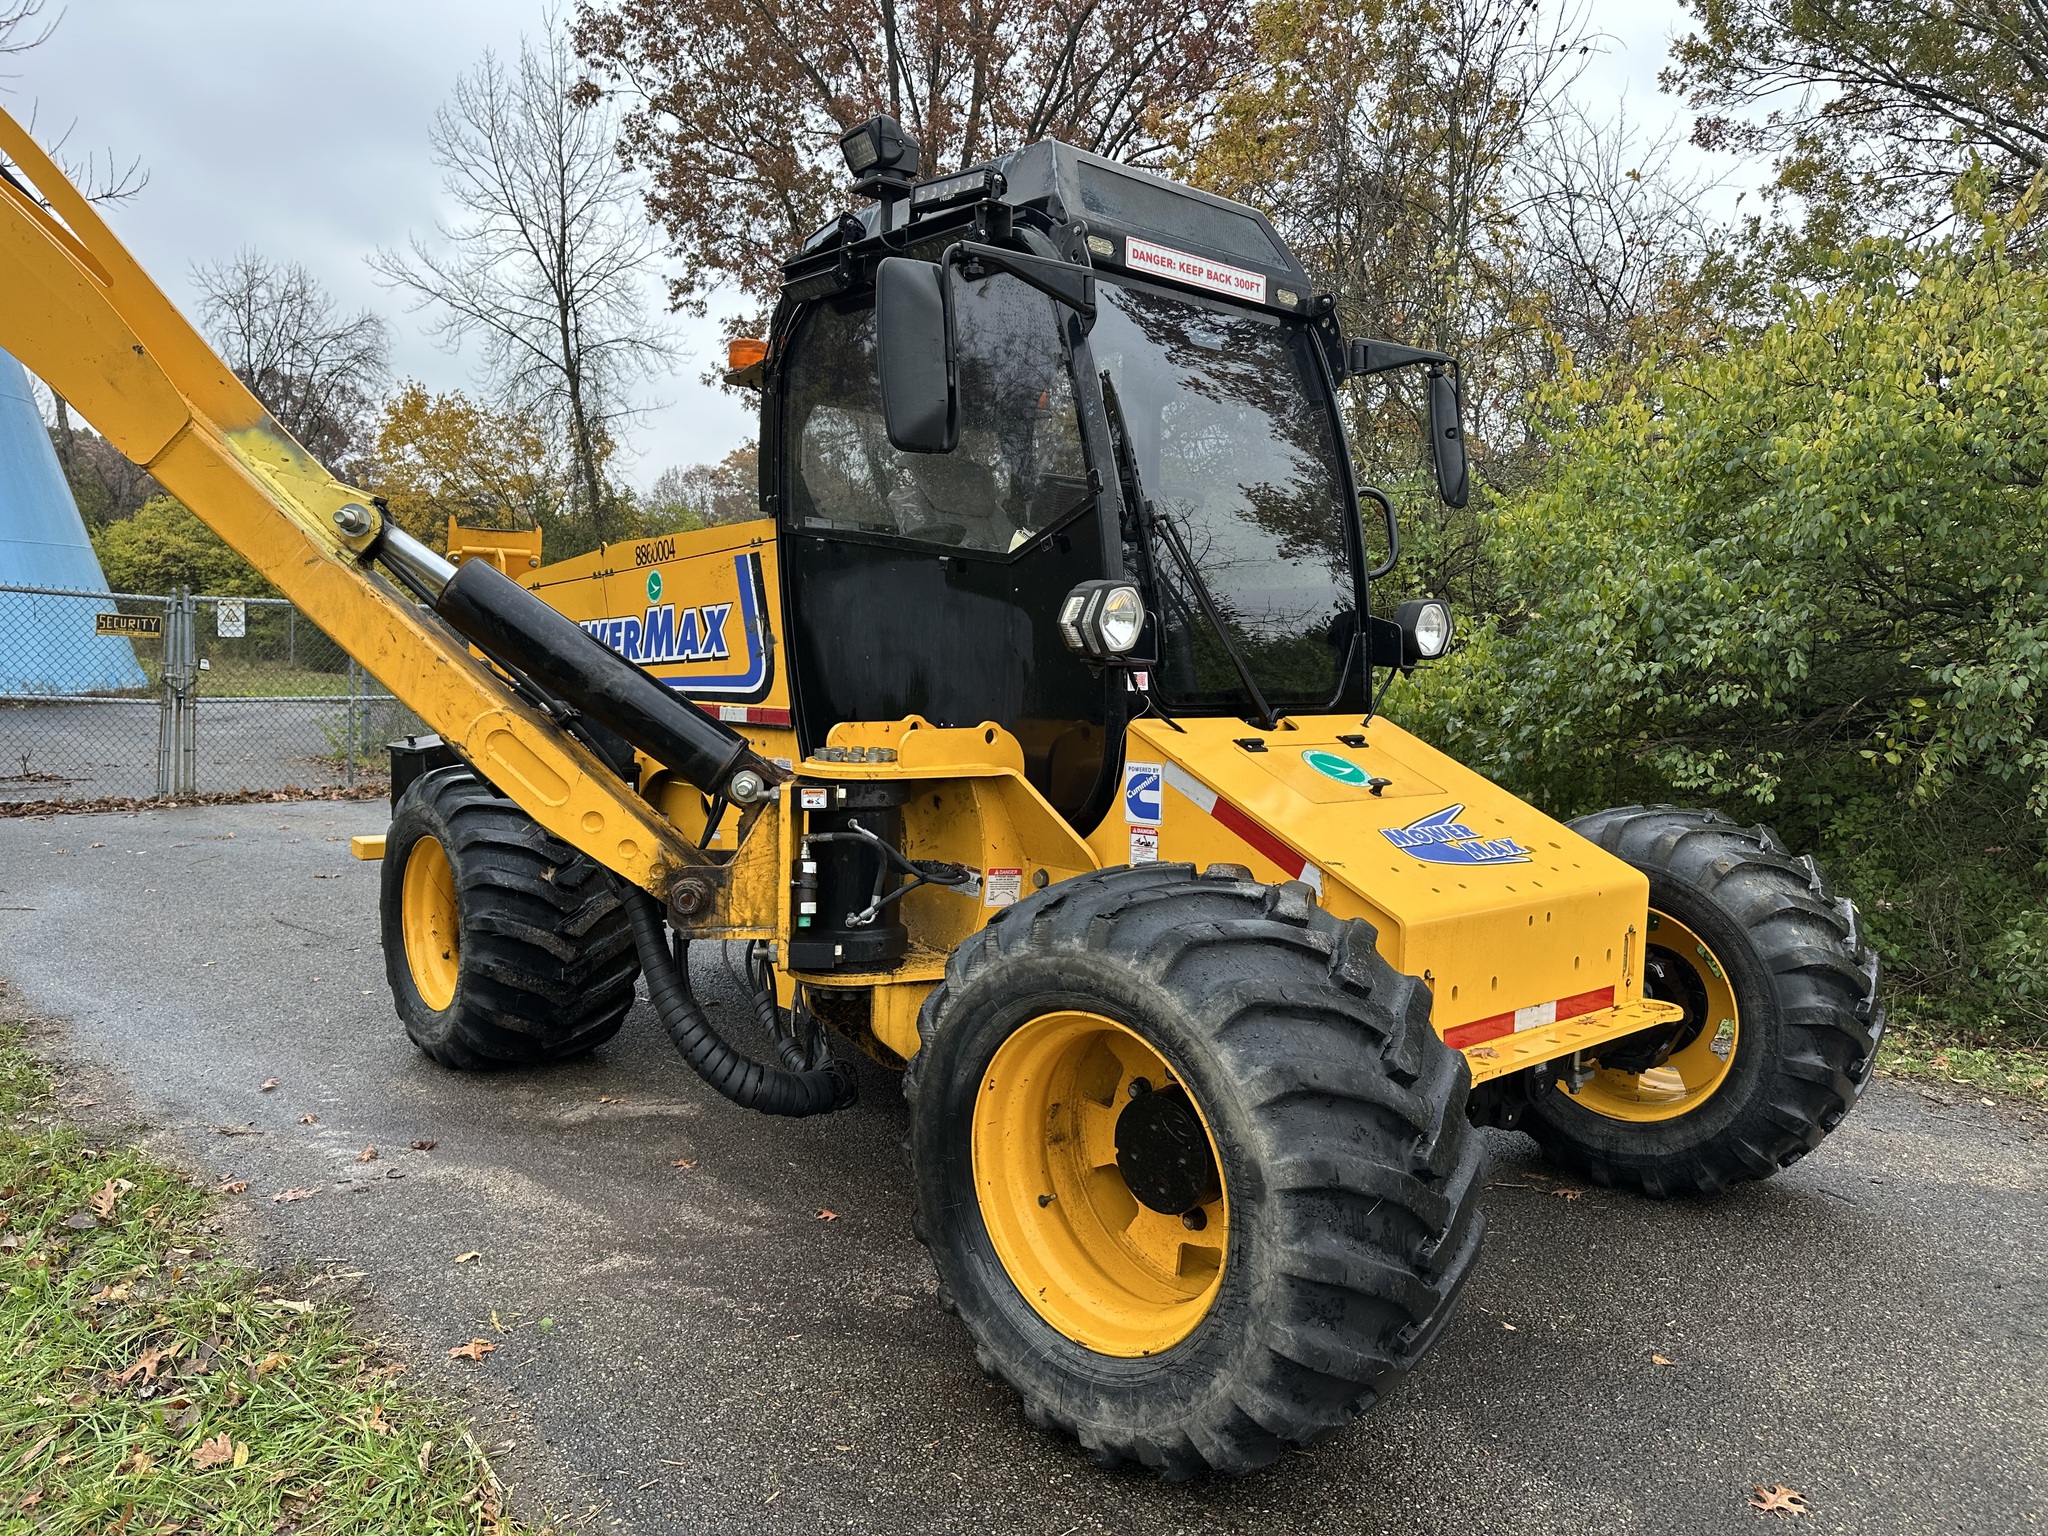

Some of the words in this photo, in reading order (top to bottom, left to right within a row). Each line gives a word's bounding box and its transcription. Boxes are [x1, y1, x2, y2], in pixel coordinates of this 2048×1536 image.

[1132, 247, 1176, 270] DANGER:
[1178, 261, 1204, 277] KEEP
[1207, 269, 1232, 286] BACK
[1234, 277, 1261, 293] 300FT
[99, 615, 158, 631] SECURITY
[579, 602, 733, 665] WERMAX
[1127, 774, 1158, 798] Cummins
[1378, 822, 1483, 849] MOWER
[1459, 837, 1532, 861] MAX
